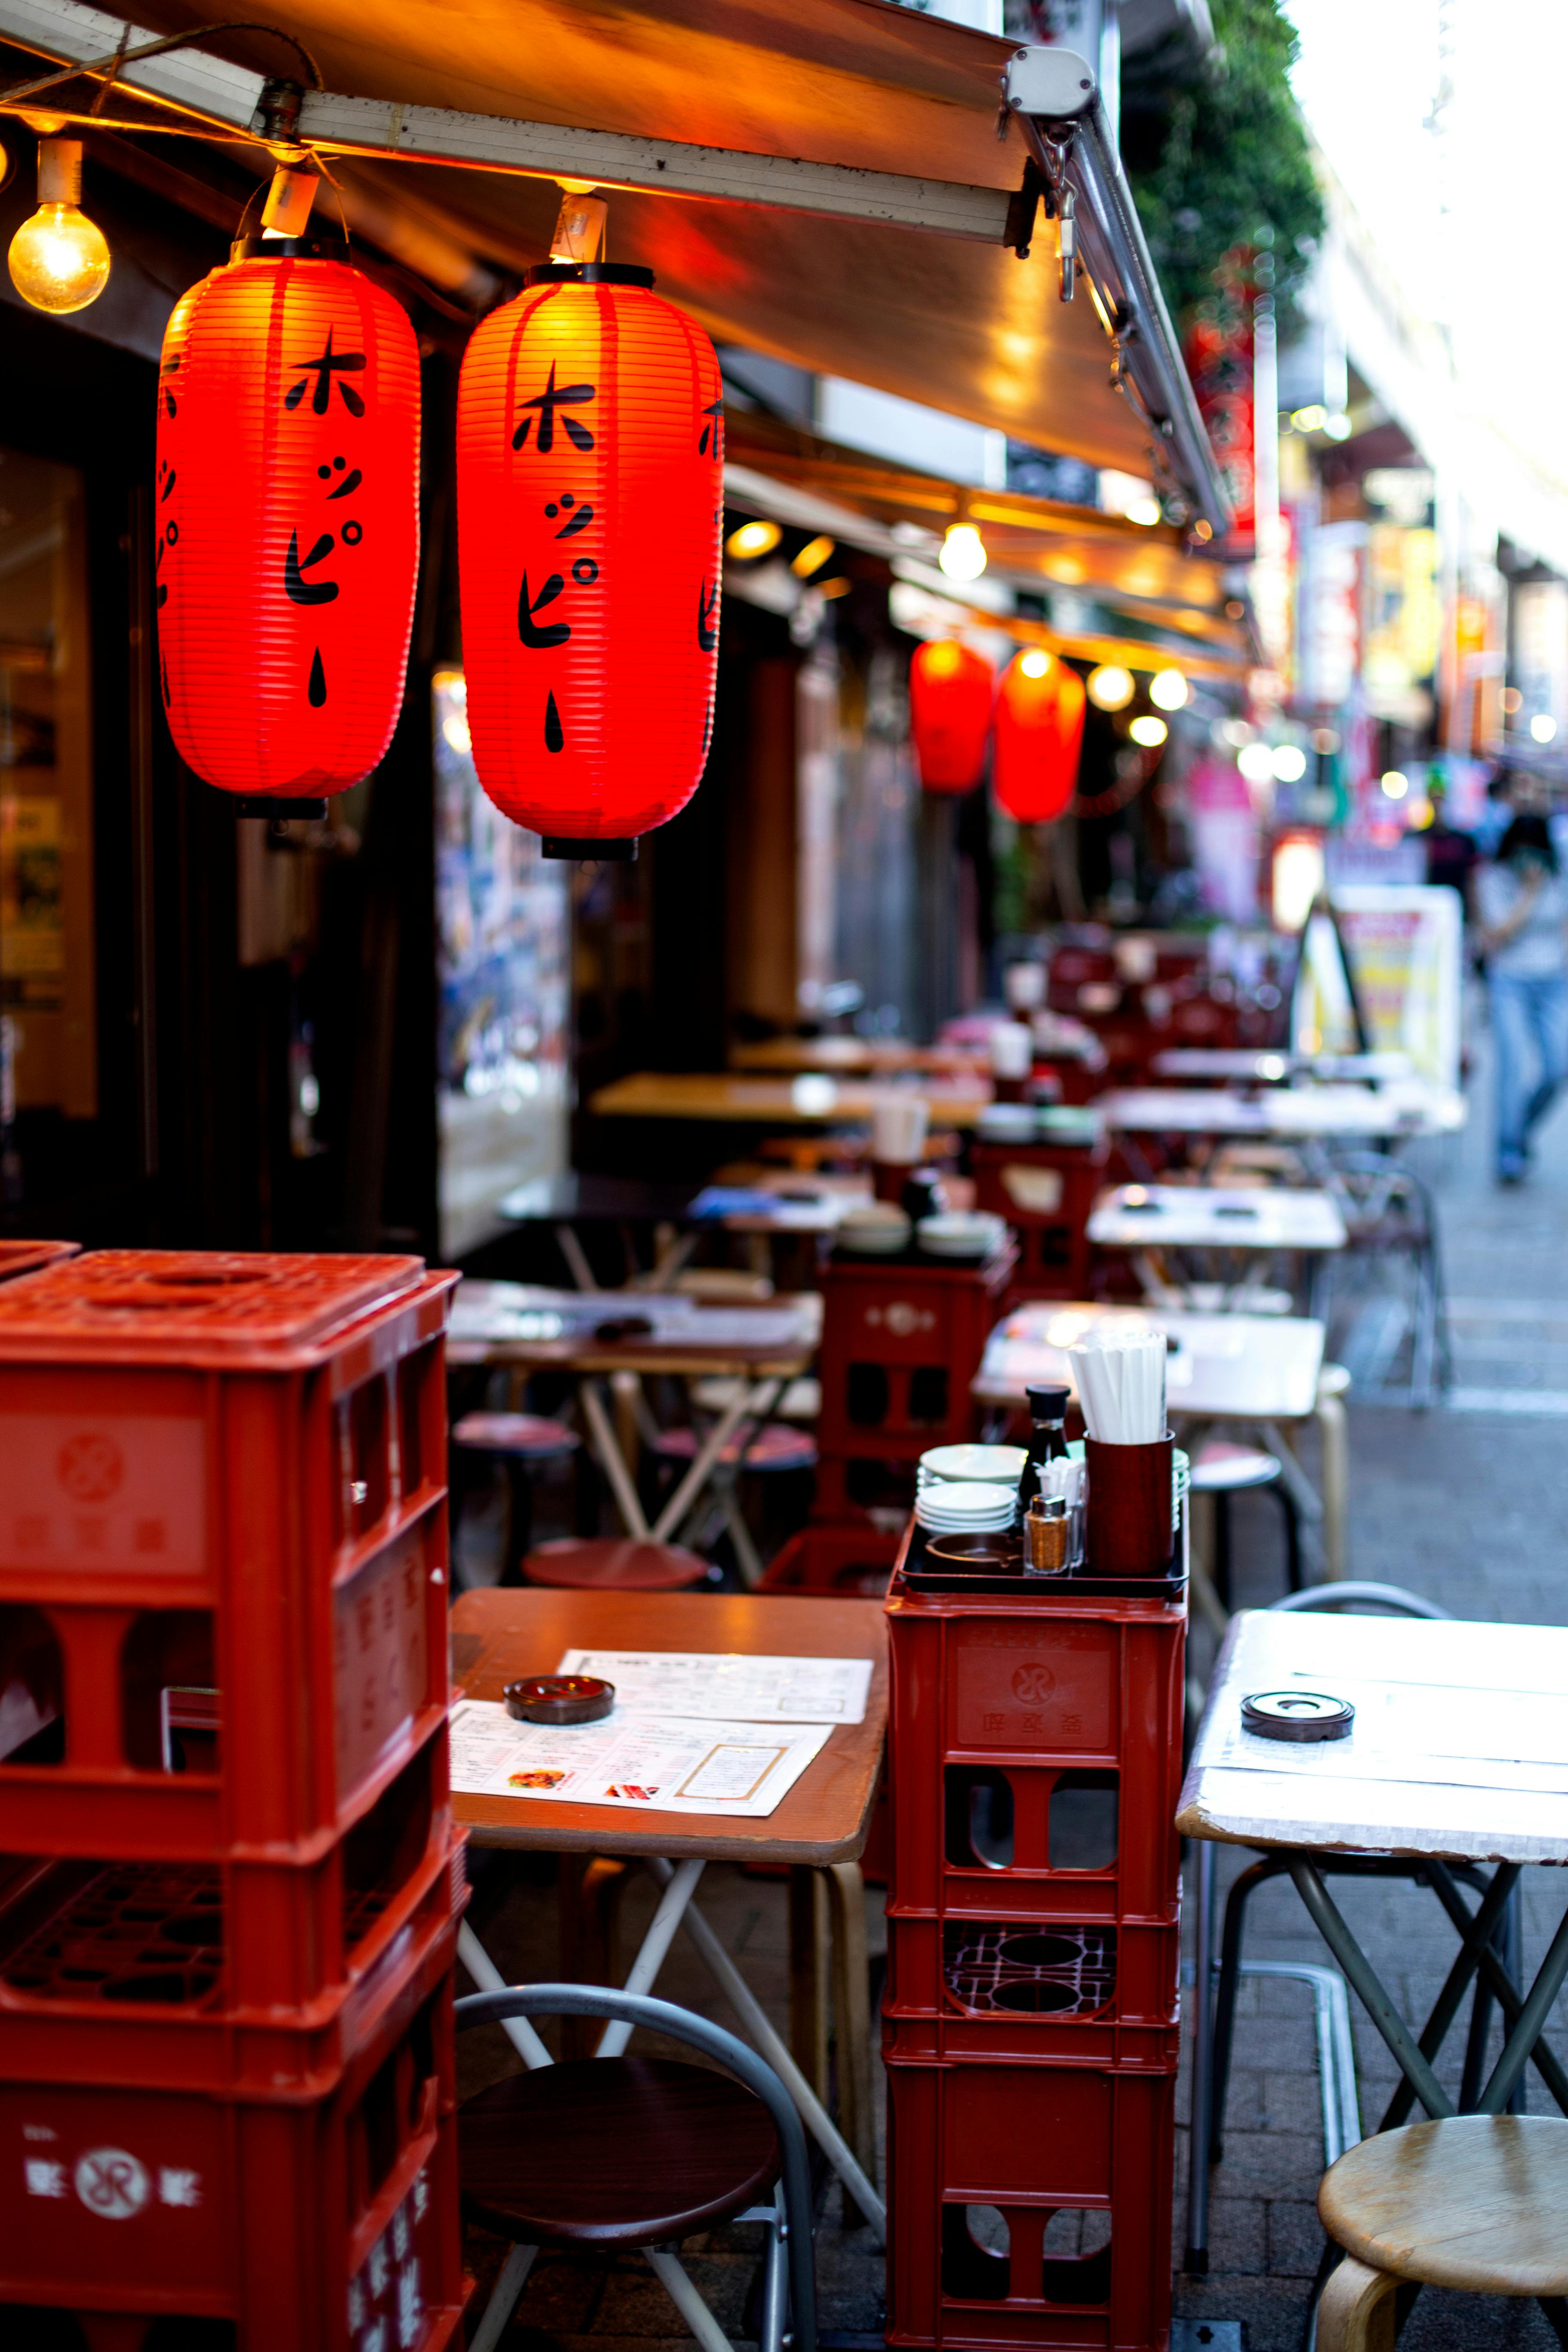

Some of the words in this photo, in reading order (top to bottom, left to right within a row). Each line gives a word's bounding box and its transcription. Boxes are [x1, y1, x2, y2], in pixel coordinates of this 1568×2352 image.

[285, 324, 366, 707] ホッピー
[512, 358, 598, 753] ホッピー
